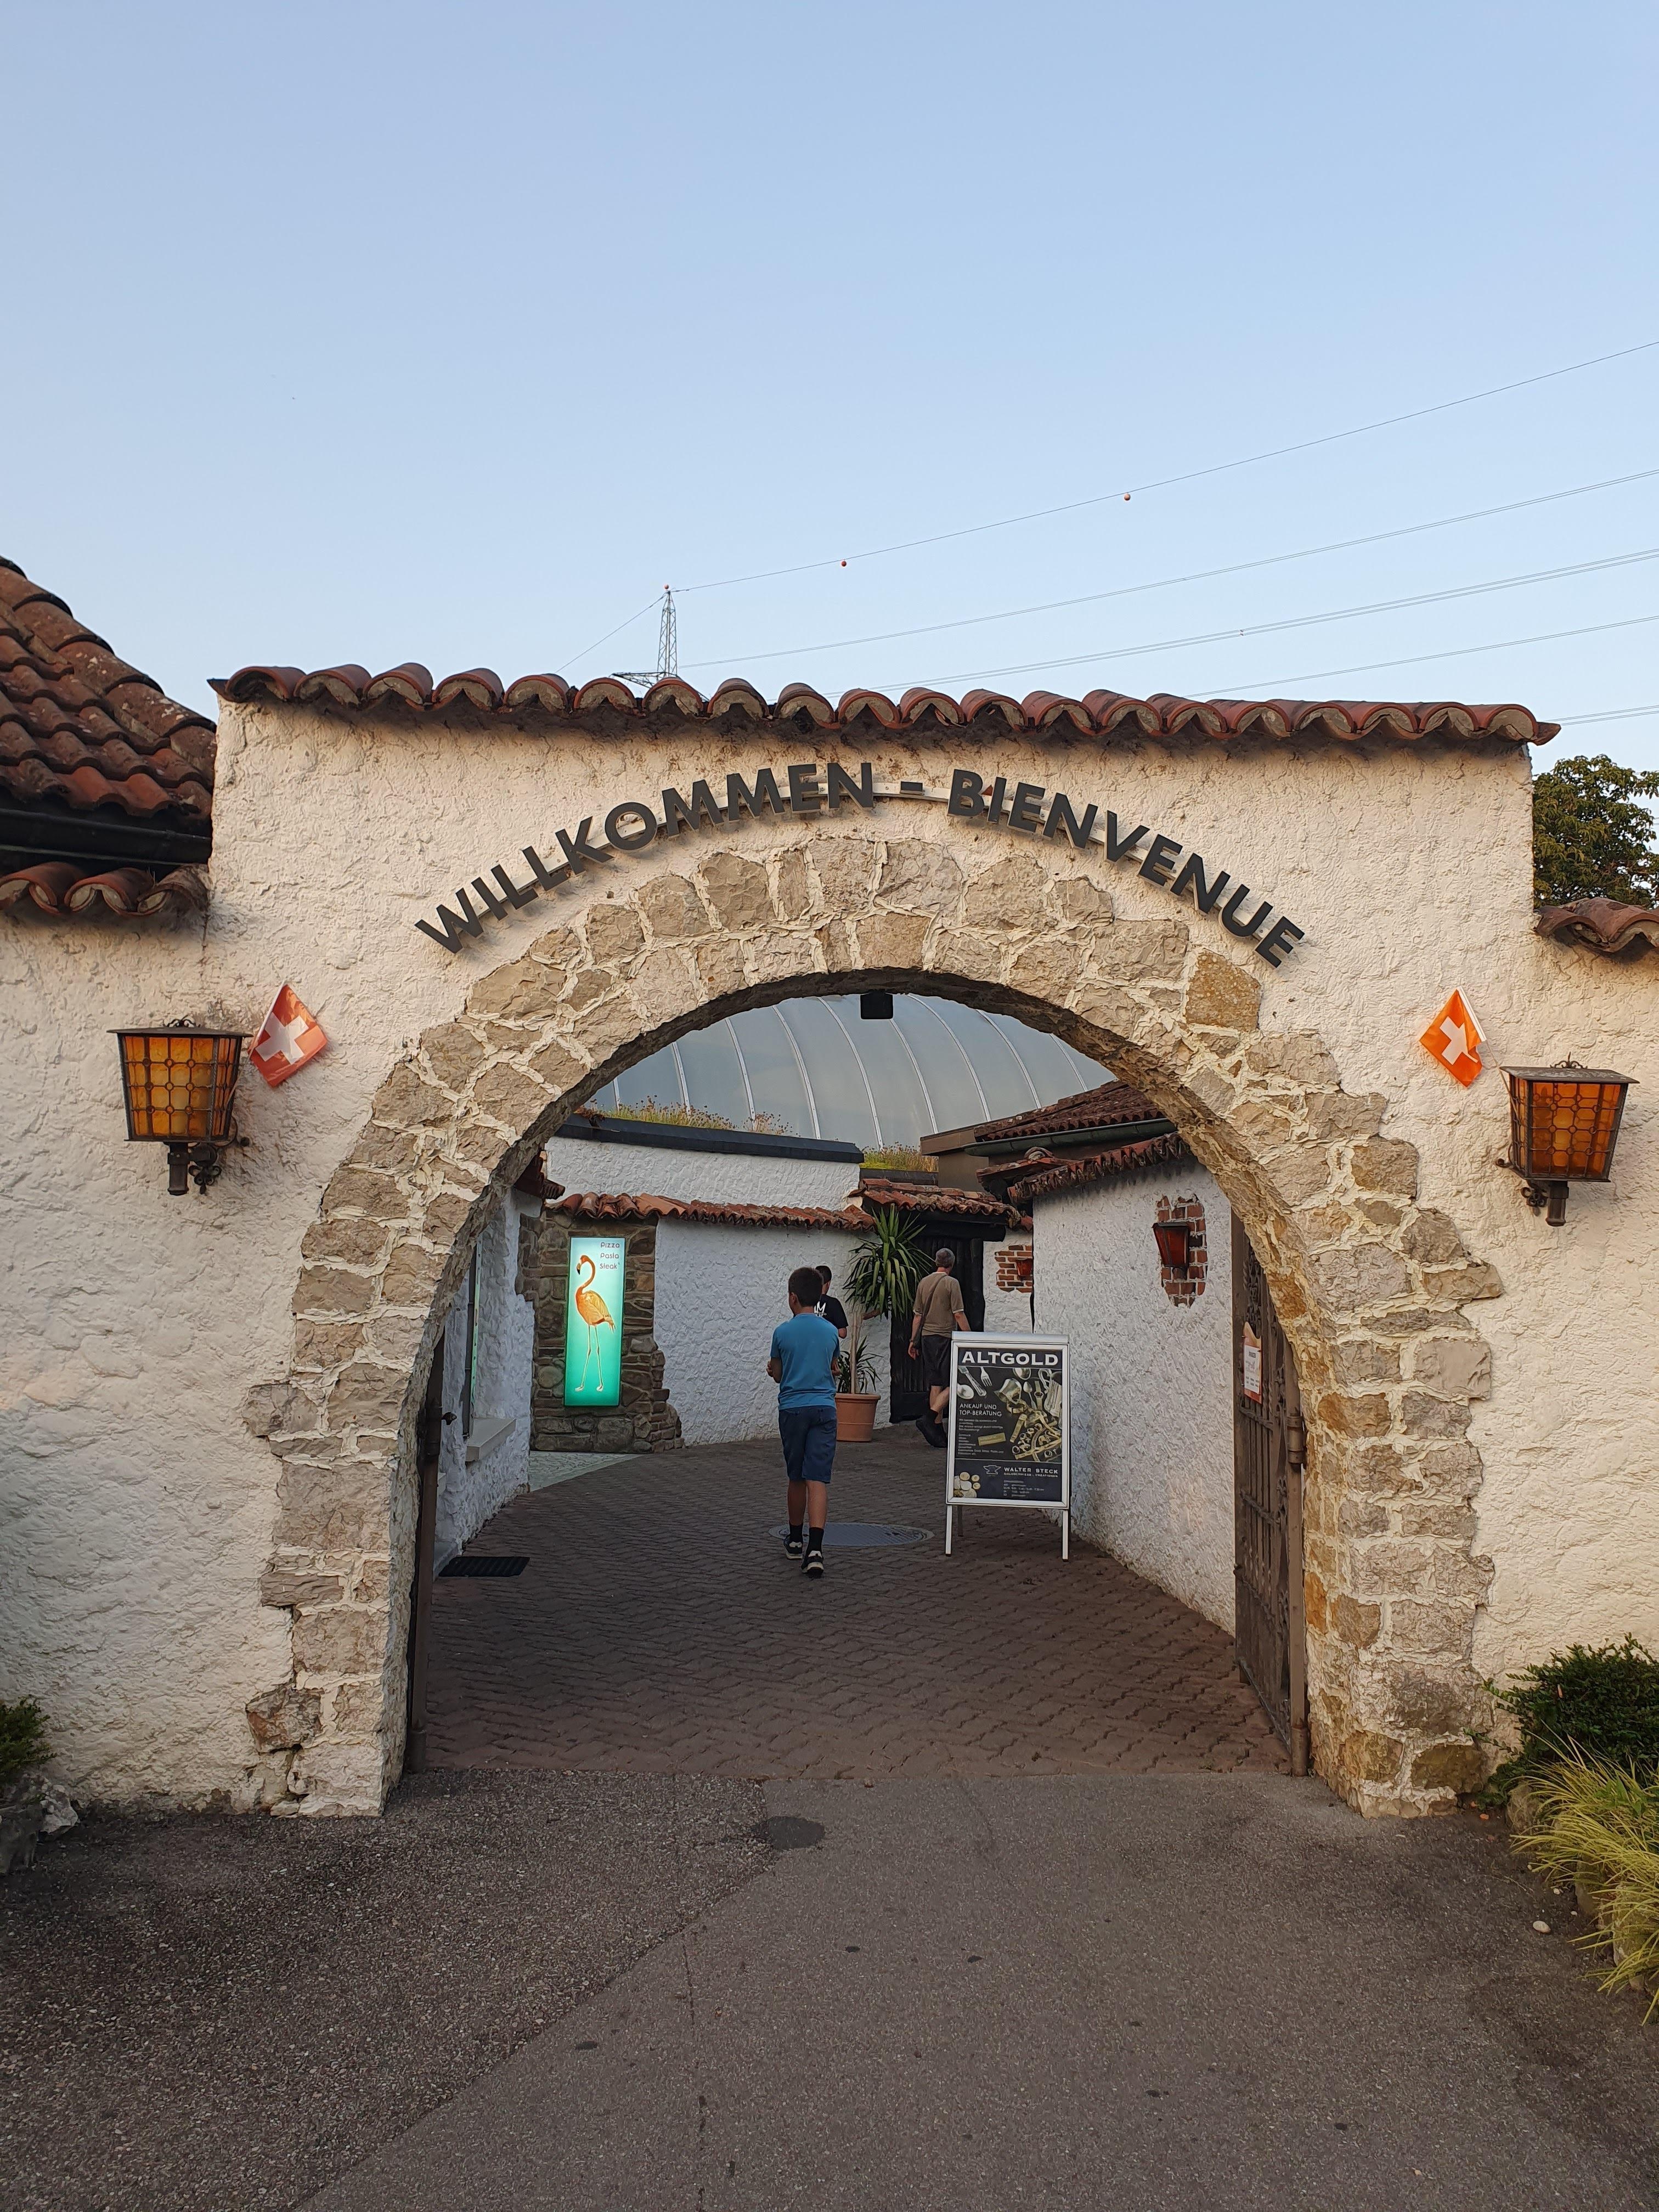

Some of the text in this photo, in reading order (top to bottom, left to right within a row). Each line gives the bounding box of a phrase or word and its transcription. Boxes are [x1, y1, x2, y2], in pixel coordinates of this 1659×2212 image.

[414, 762, 874, 955] WILLKOMMEN
[946, 769, 1306, 970] BIENVENUE
[961, 1351, 1058, 1366] ALTGOLD
